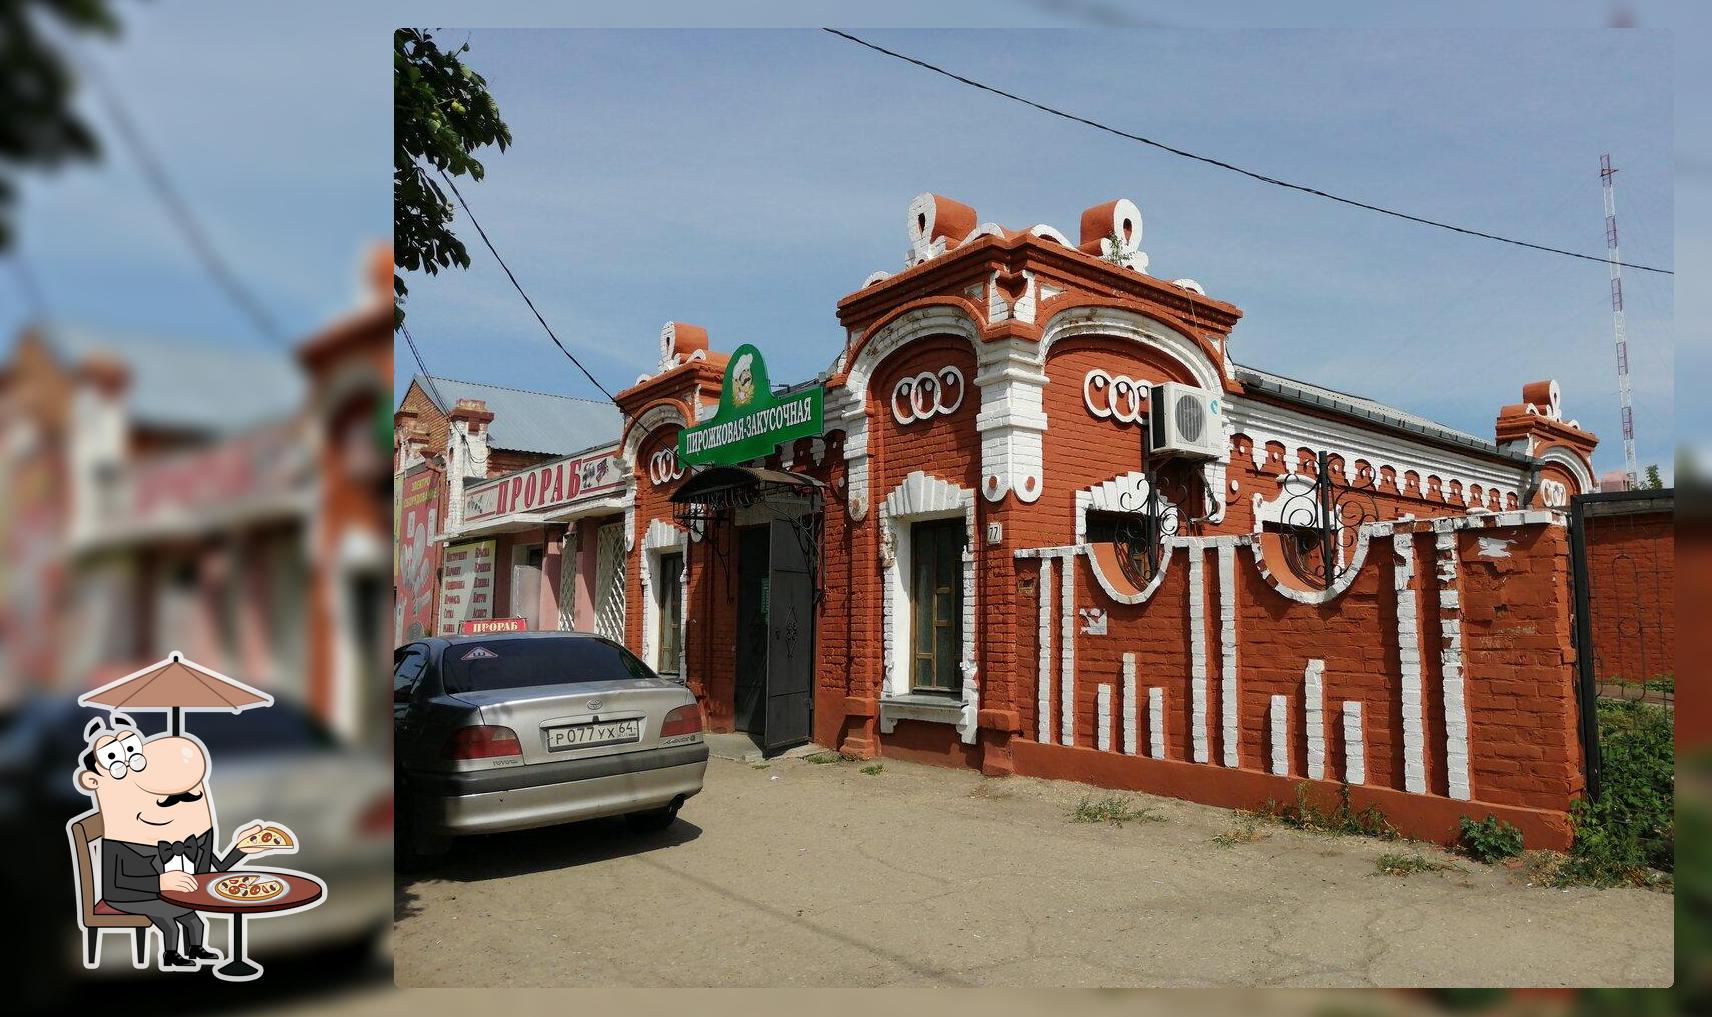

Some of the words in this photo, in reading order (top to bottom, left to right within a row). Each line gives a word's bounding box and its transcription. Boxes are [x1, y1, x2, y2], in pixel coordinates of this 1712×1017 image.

[686, 397, 812, 455] ПИРОЖКОВАЯ-ЗАКУСОЧНАЯ
[496, 459, 583, 515] ПРОРАБ
[989, 526, 998, 540] 77
[473, 621, 518, 633] ПРОРАБ
[556, 726, 615, 745] Р077УХ
[618, 722, 633, 734] 64
